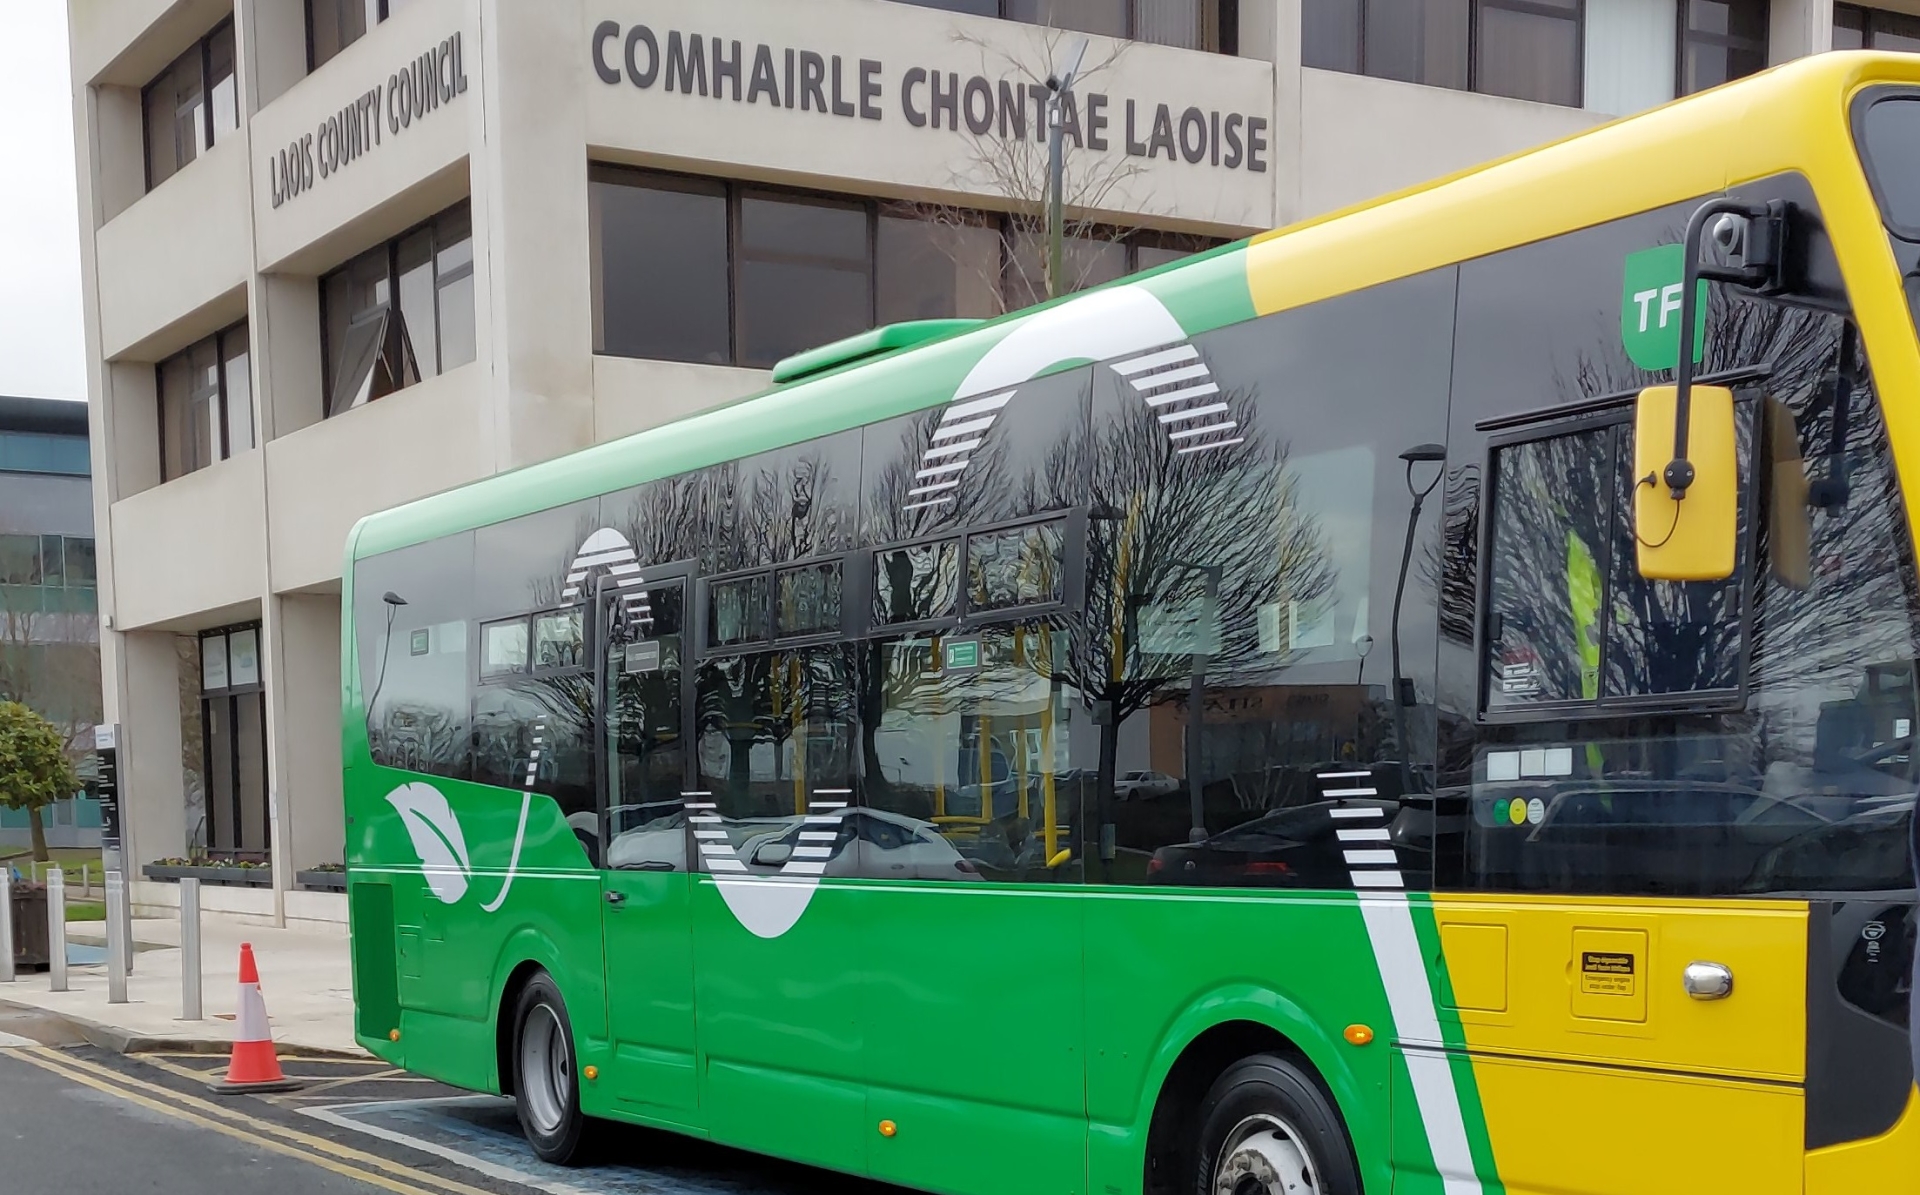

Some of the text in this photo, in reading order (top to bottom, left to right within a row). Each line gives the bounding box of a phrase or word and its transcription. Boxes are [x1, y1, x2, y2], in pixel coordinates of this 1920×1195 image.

[270, 31, 468, 209] LAOIS COUNTY COUNCIL
[592, 20, 1268, 173] COMHAIRLE CHONTAE LAOISE
[1634, 282, 1684, 333] TF
